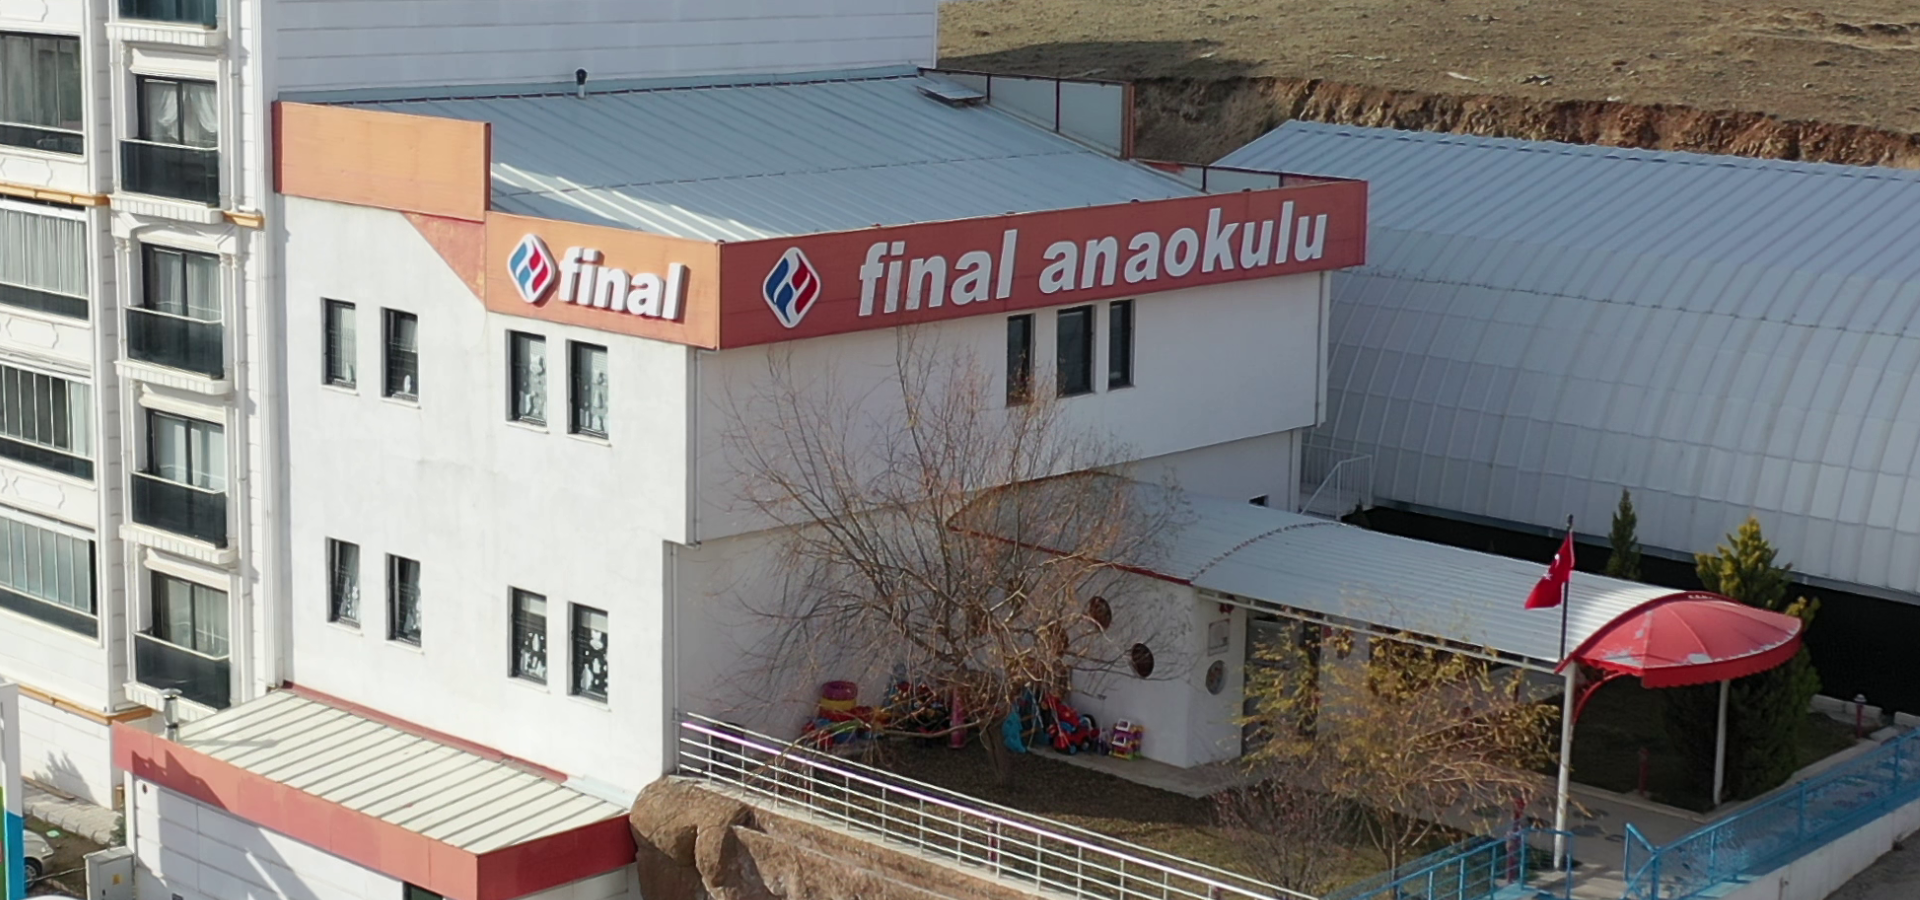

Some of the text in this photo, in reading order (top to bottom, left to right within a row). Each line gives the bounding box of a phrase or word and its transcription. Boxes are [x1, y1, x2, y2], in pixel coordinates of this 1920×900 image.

[558, 246, 683, 320] final
[858, 201, 1328, 317] final anaokulu
